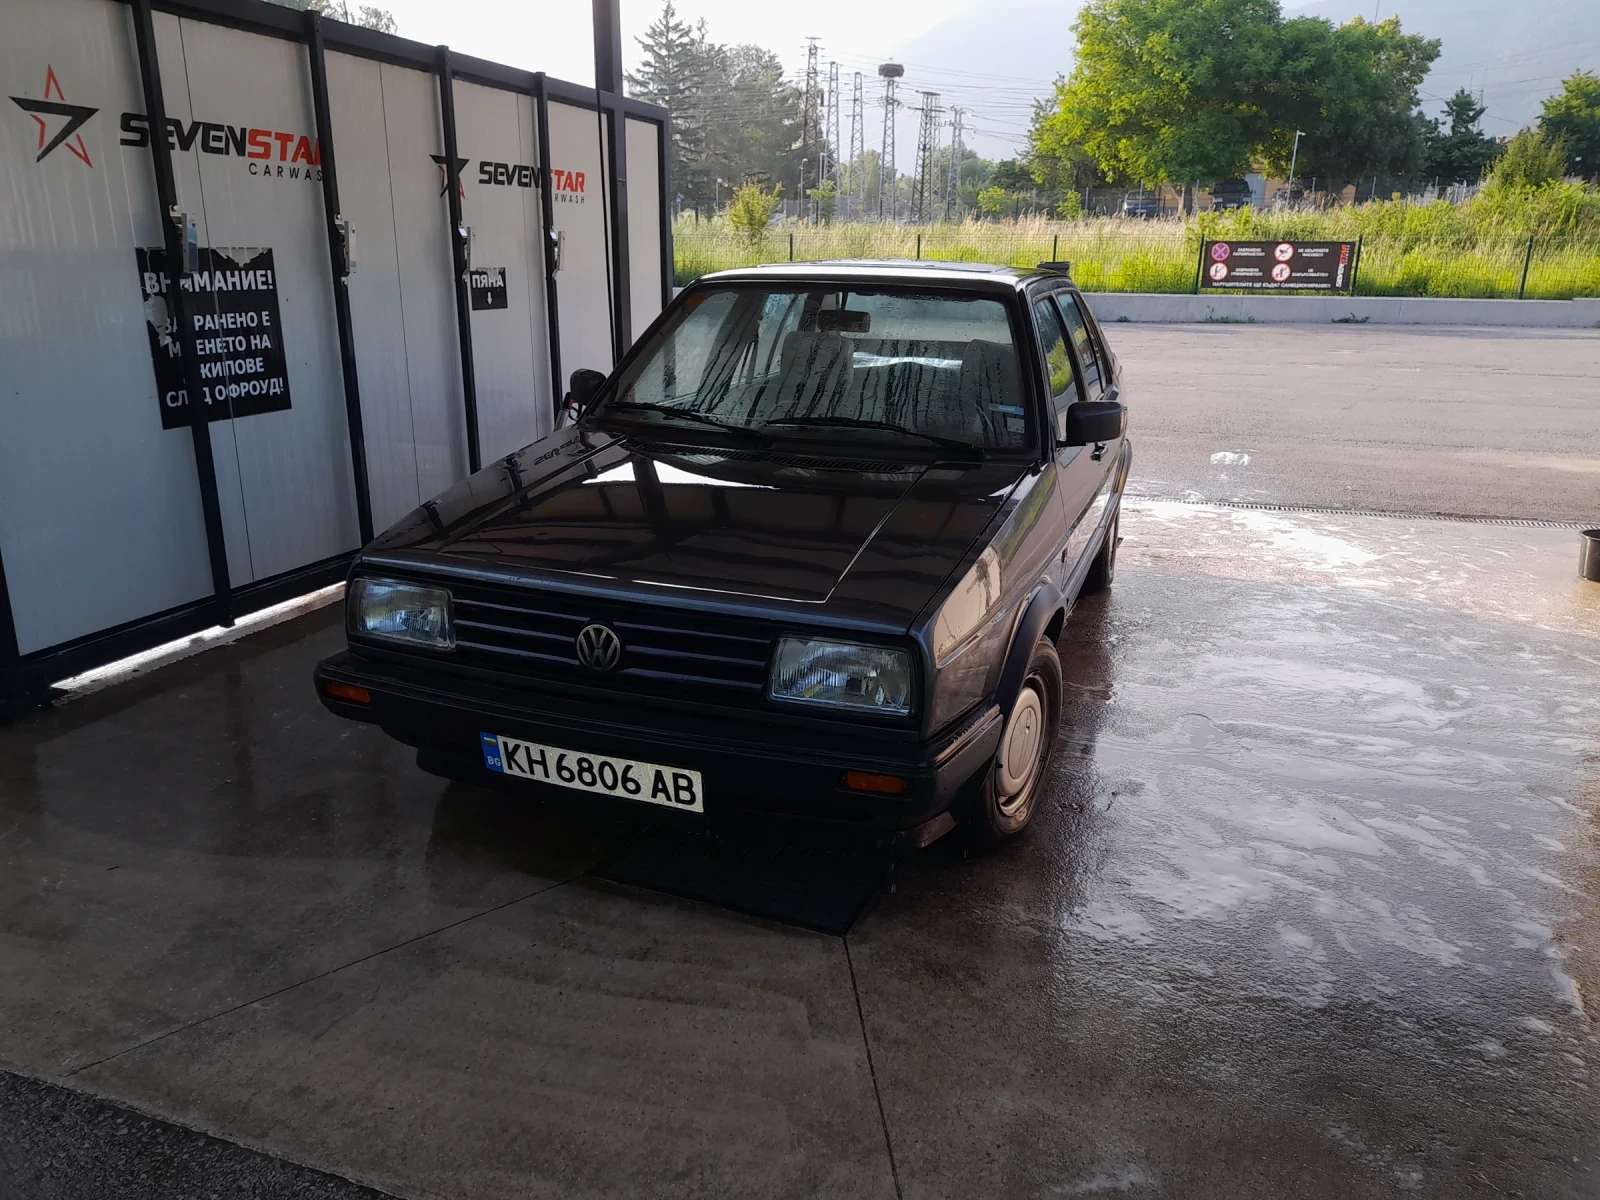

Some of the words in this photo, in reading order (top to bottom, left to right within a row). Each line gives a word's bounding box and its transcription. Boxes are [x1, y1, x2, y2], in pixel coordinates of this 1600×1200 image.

[119, 112, 321, 166] SVENSTA
[248, 162, 323, 181] CARWAS
[478, 161, 585, 192] SEVENTAR
[554, 193, 586, 204] RWASH
[472, 274, 504, 289] ПЯНА
[262, 311, 271, 326] Е
[251, 333, 272, 350] НА
[215, 377, 284, 401] ОФРОУД!
[487, 755, 502, 767] BG
[556, 753, 642, 796] 6806
[650, 769, 697, 806] AB
